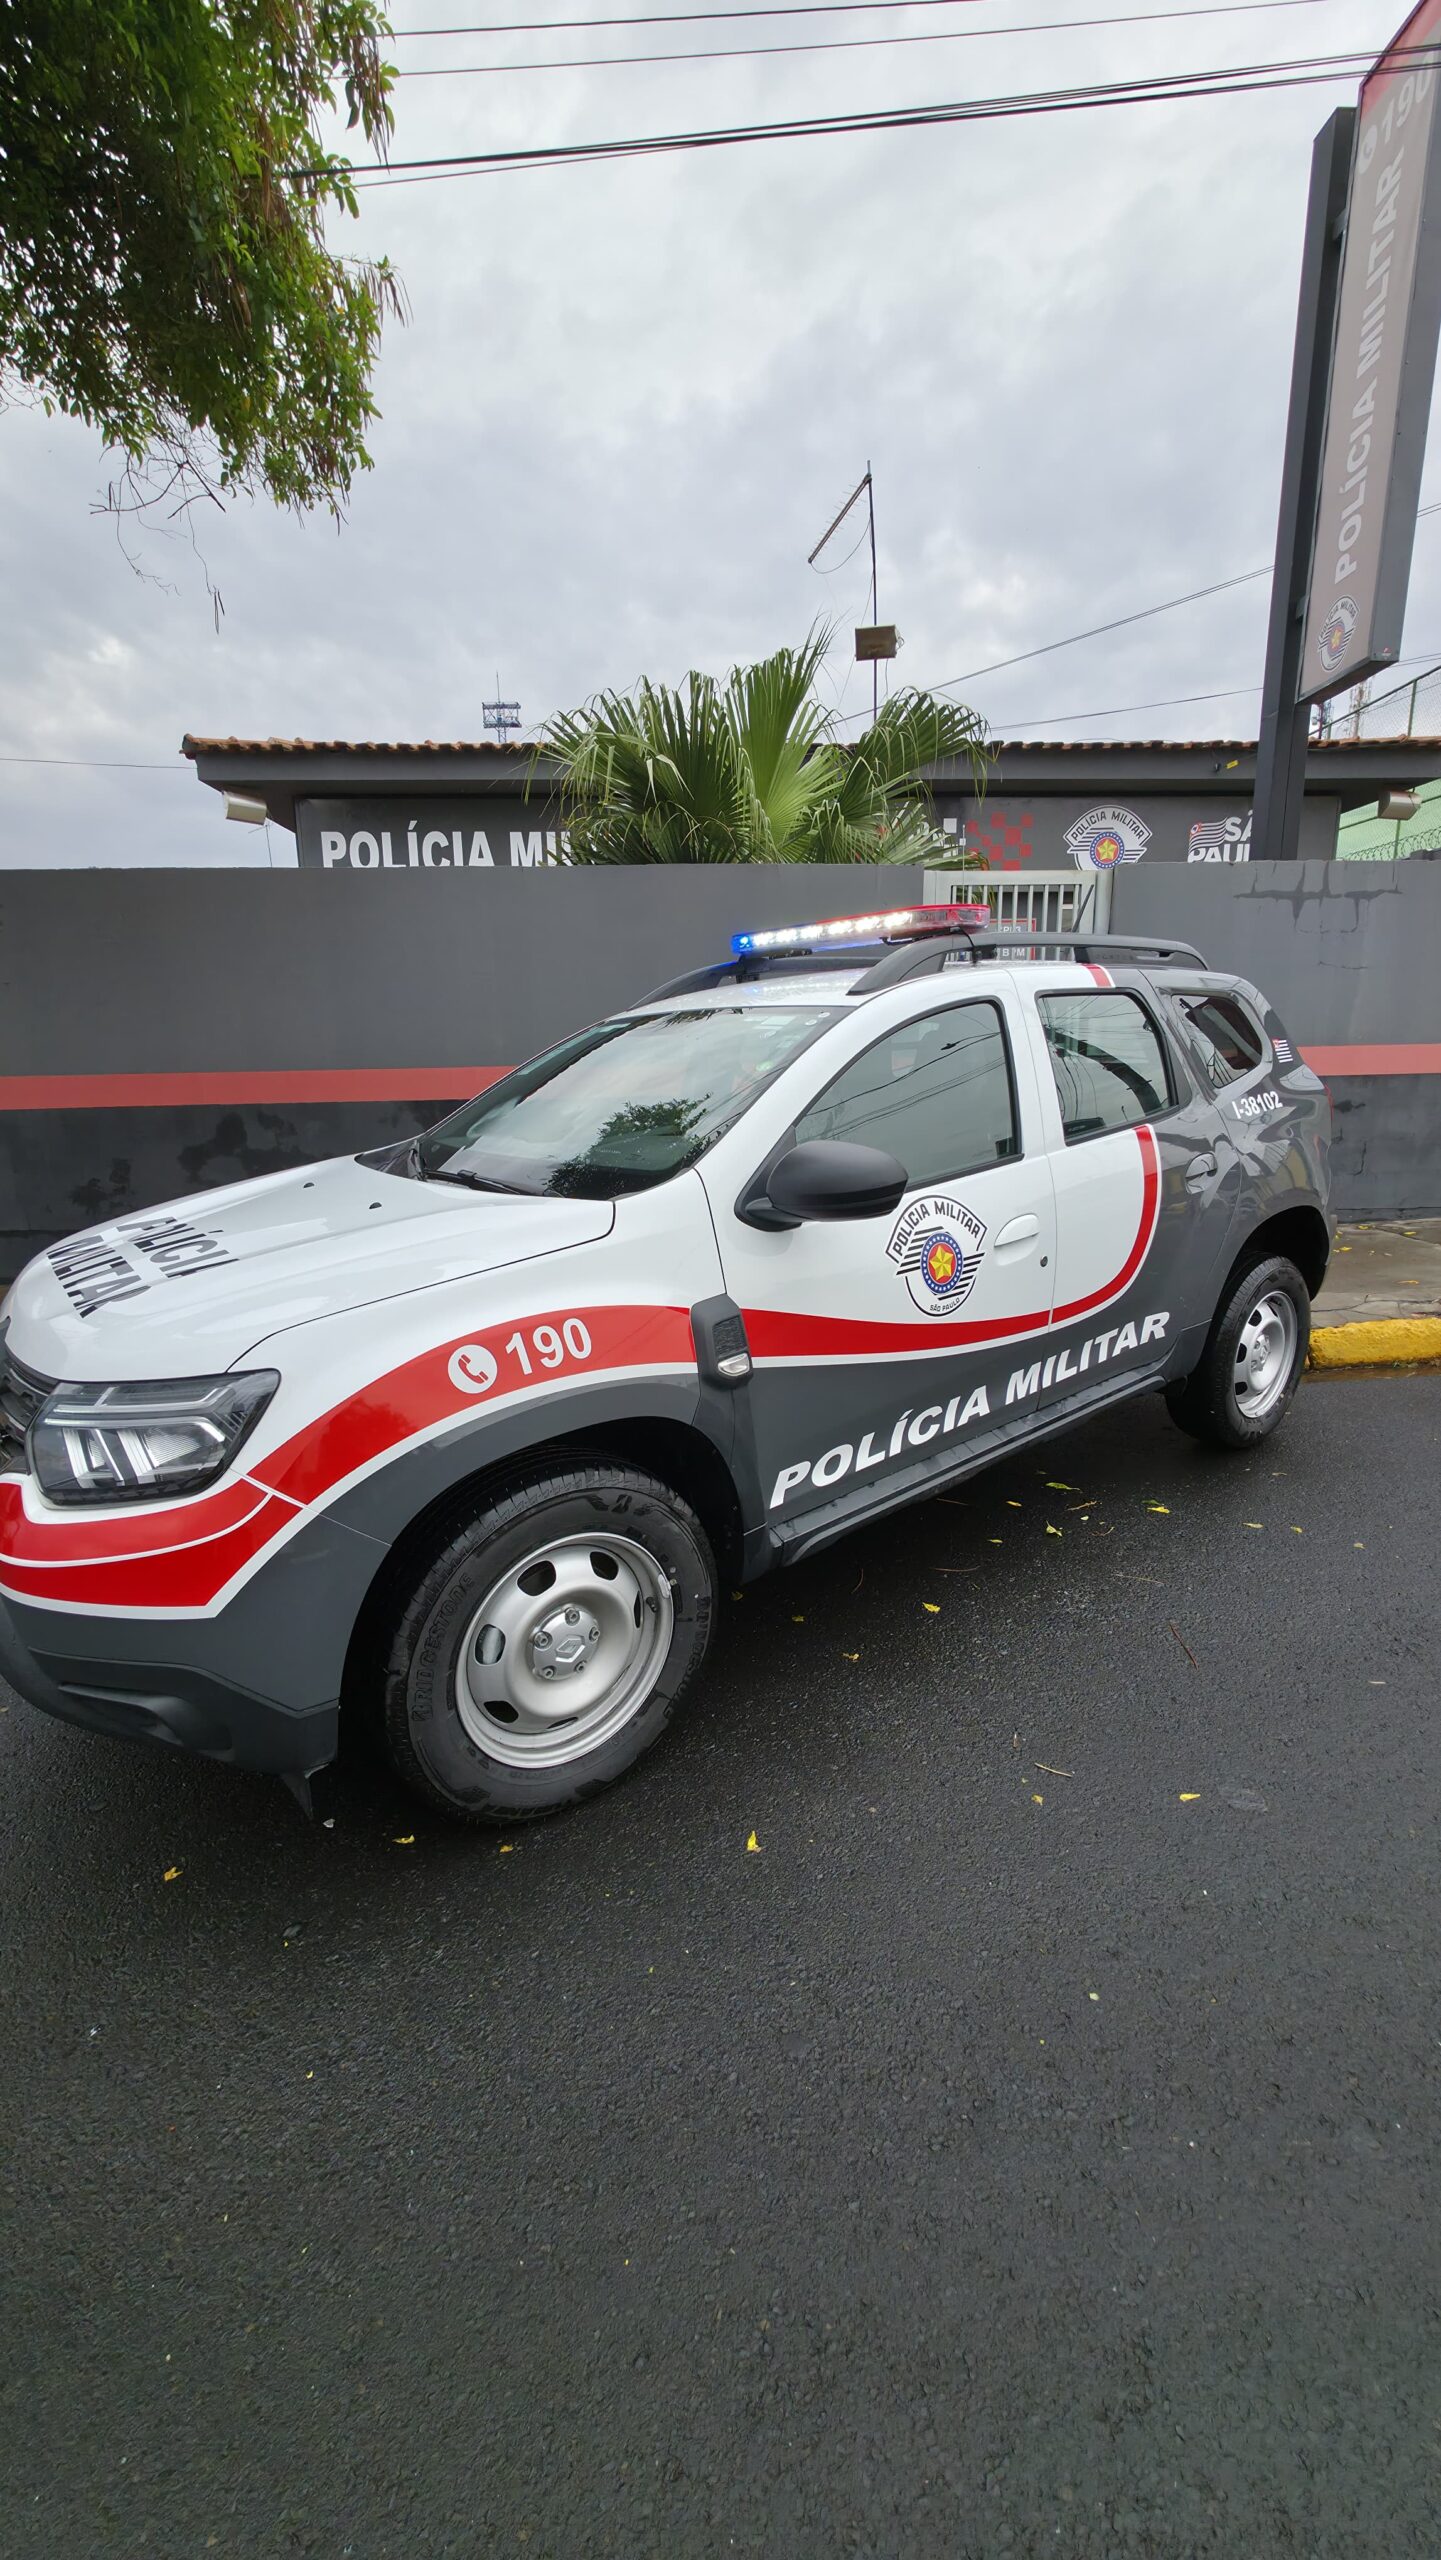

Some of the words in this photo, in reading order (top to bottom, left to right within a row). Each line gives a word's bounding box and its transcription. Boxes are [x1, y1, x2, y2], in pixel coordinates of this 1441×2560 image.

[1381, 50, 1435, 145] 190
[1334, 377, 1377, 585] POLÍCIA
[1356, 147, 1405, 380] MILITAR
[320, 820, 495, 868] POLÍCIA
[1070, 810, 1107, 841] POLÍCIA
[1111, 810, 1145, 839] MILITAR
[1232, 1091, 1283, 1119] I-38102
[892, 1203, 931, 1257] POLÍCIA
[934, 1201, 981, 1238] MILITAR
[929, 1304, 942, 1312] SÃO
[941, 1297, 961, 1312] PAULO
[505, 1317, 592, 1376] 190
[769, 1385, 991, 1510] POLÍCIA
[1005, 1311, 1170, 1405] MILITAR
